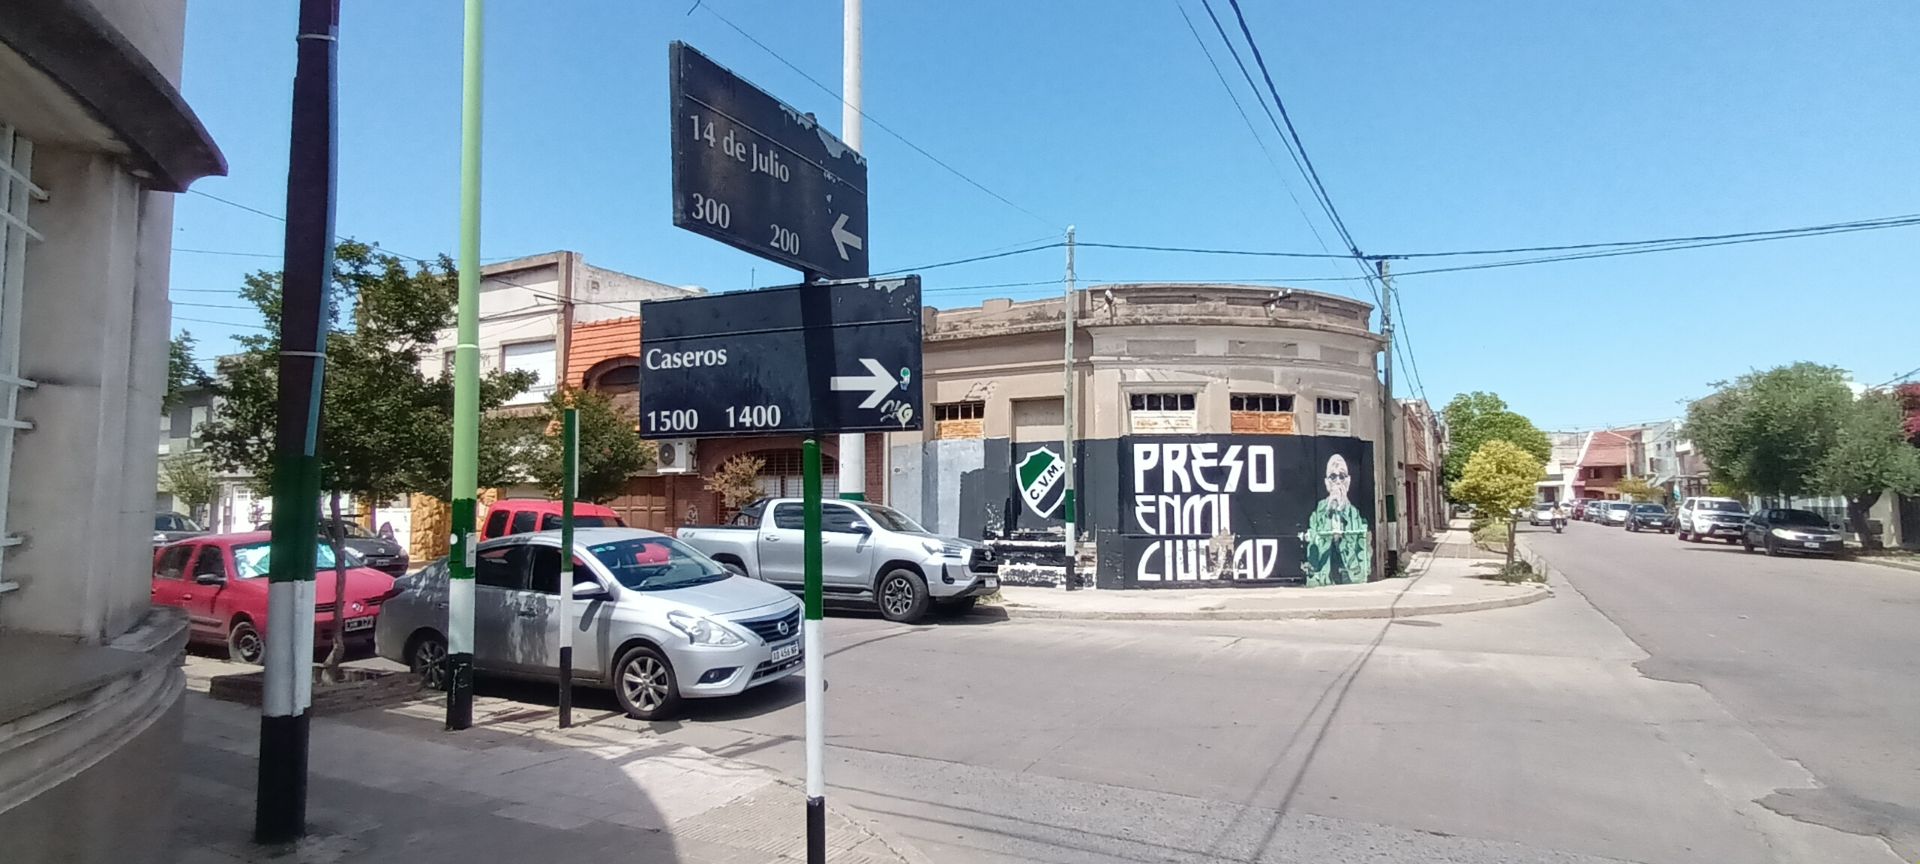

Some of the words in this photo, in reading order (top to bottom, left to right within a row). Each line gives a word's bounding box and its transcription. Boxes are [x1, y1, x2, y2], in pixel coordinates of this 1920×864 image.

[690, 114, 716, 148] 14
[723, 129, 747, 162] de
[750, 143, 790, 183] Julio
[692, 192, 731, 229] 300
[770, 223, 800, 256] 200
[646, 348, 728, 370] Caseros
[647, 408, 699, 432] 1500
[725, 404, 782, 428] 1400
[1133, 442, 1275, 493] PRESO
